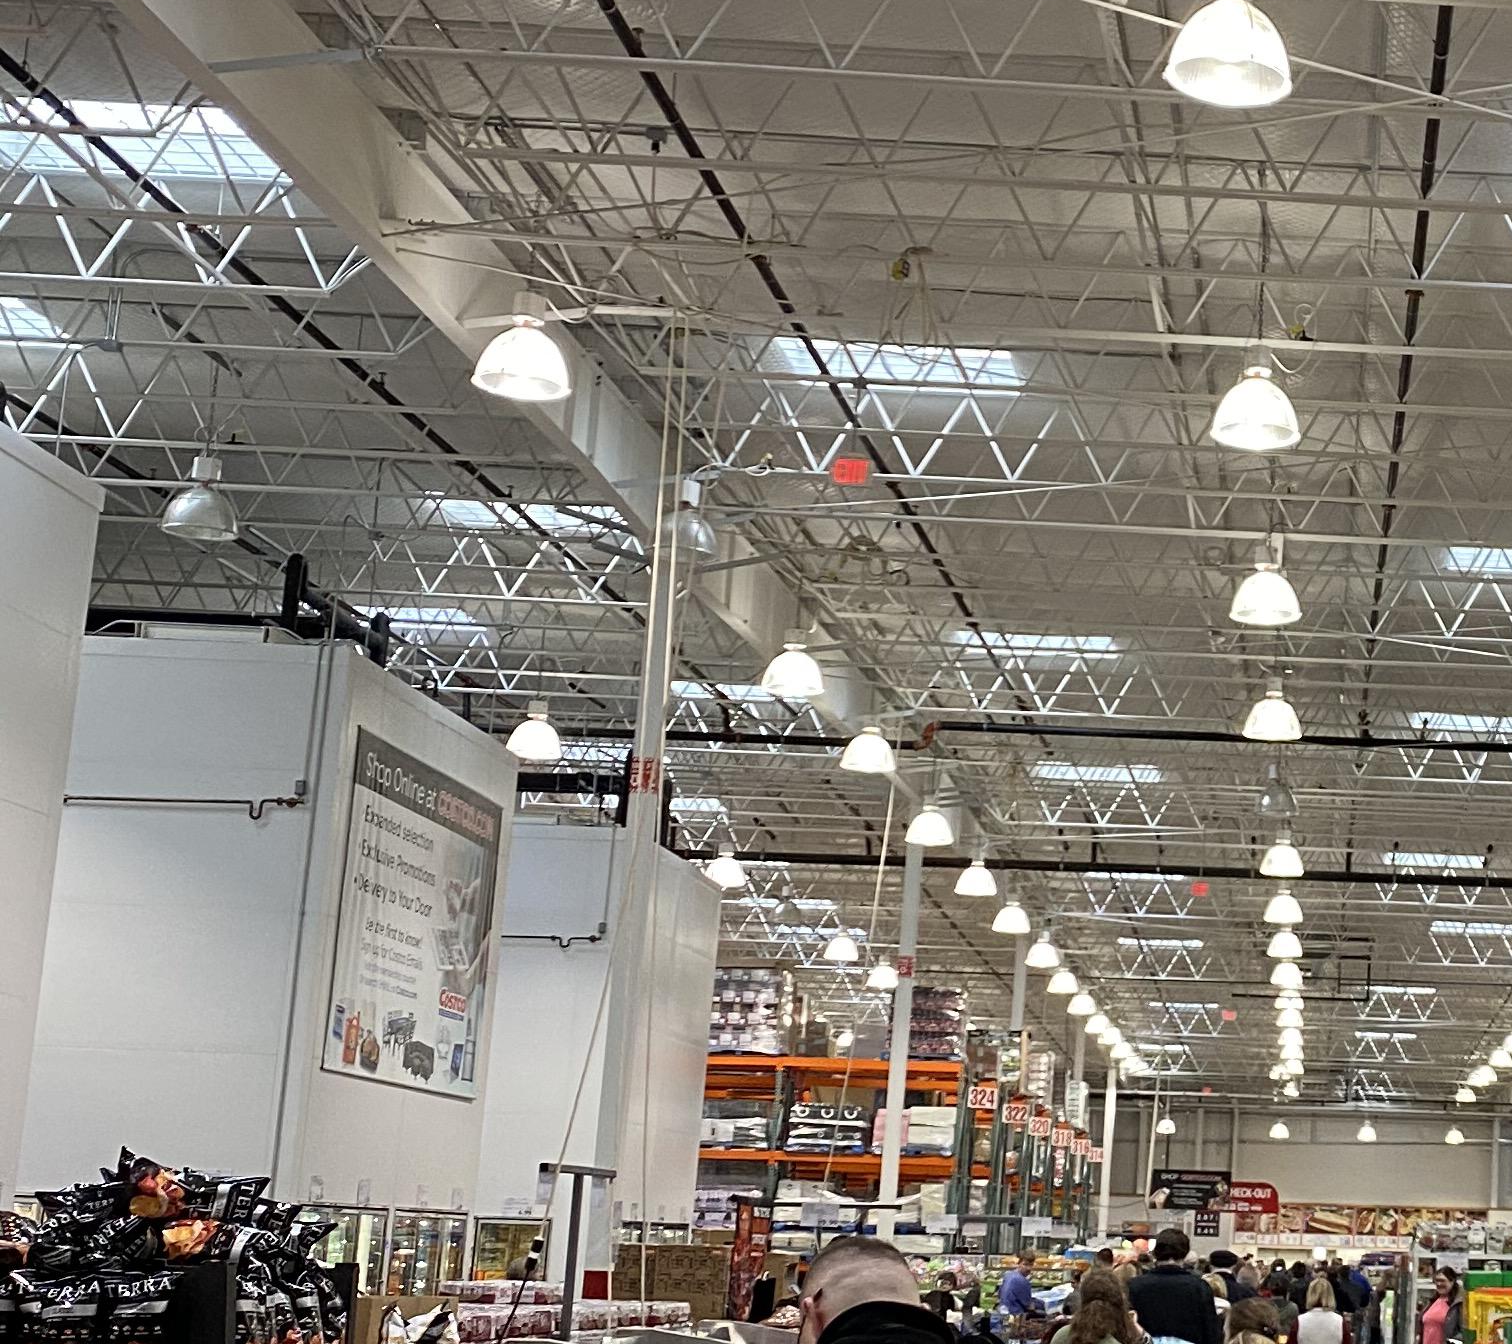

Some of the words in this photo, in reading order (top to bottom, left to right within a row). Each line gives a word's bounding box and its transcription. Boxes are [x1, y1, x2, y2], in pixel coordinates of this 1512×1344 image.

[366, 752, 391, 787] Shop
[393, 767, 425, 803] Online
[426, 788, 437, 810] at
[970, 1088, 995, 1107] 324
[1005, 1106, 1028, 1122] 322
[1030, 1119, 1049, 1134] 320
[1054, 1131, 1072, 1145] 318
[1072, 1140, 1090, 1153] 316
[1230, 1188, 1273, 1199] HECK-OUT
[104, 1276, 172, 1299] TERRA
